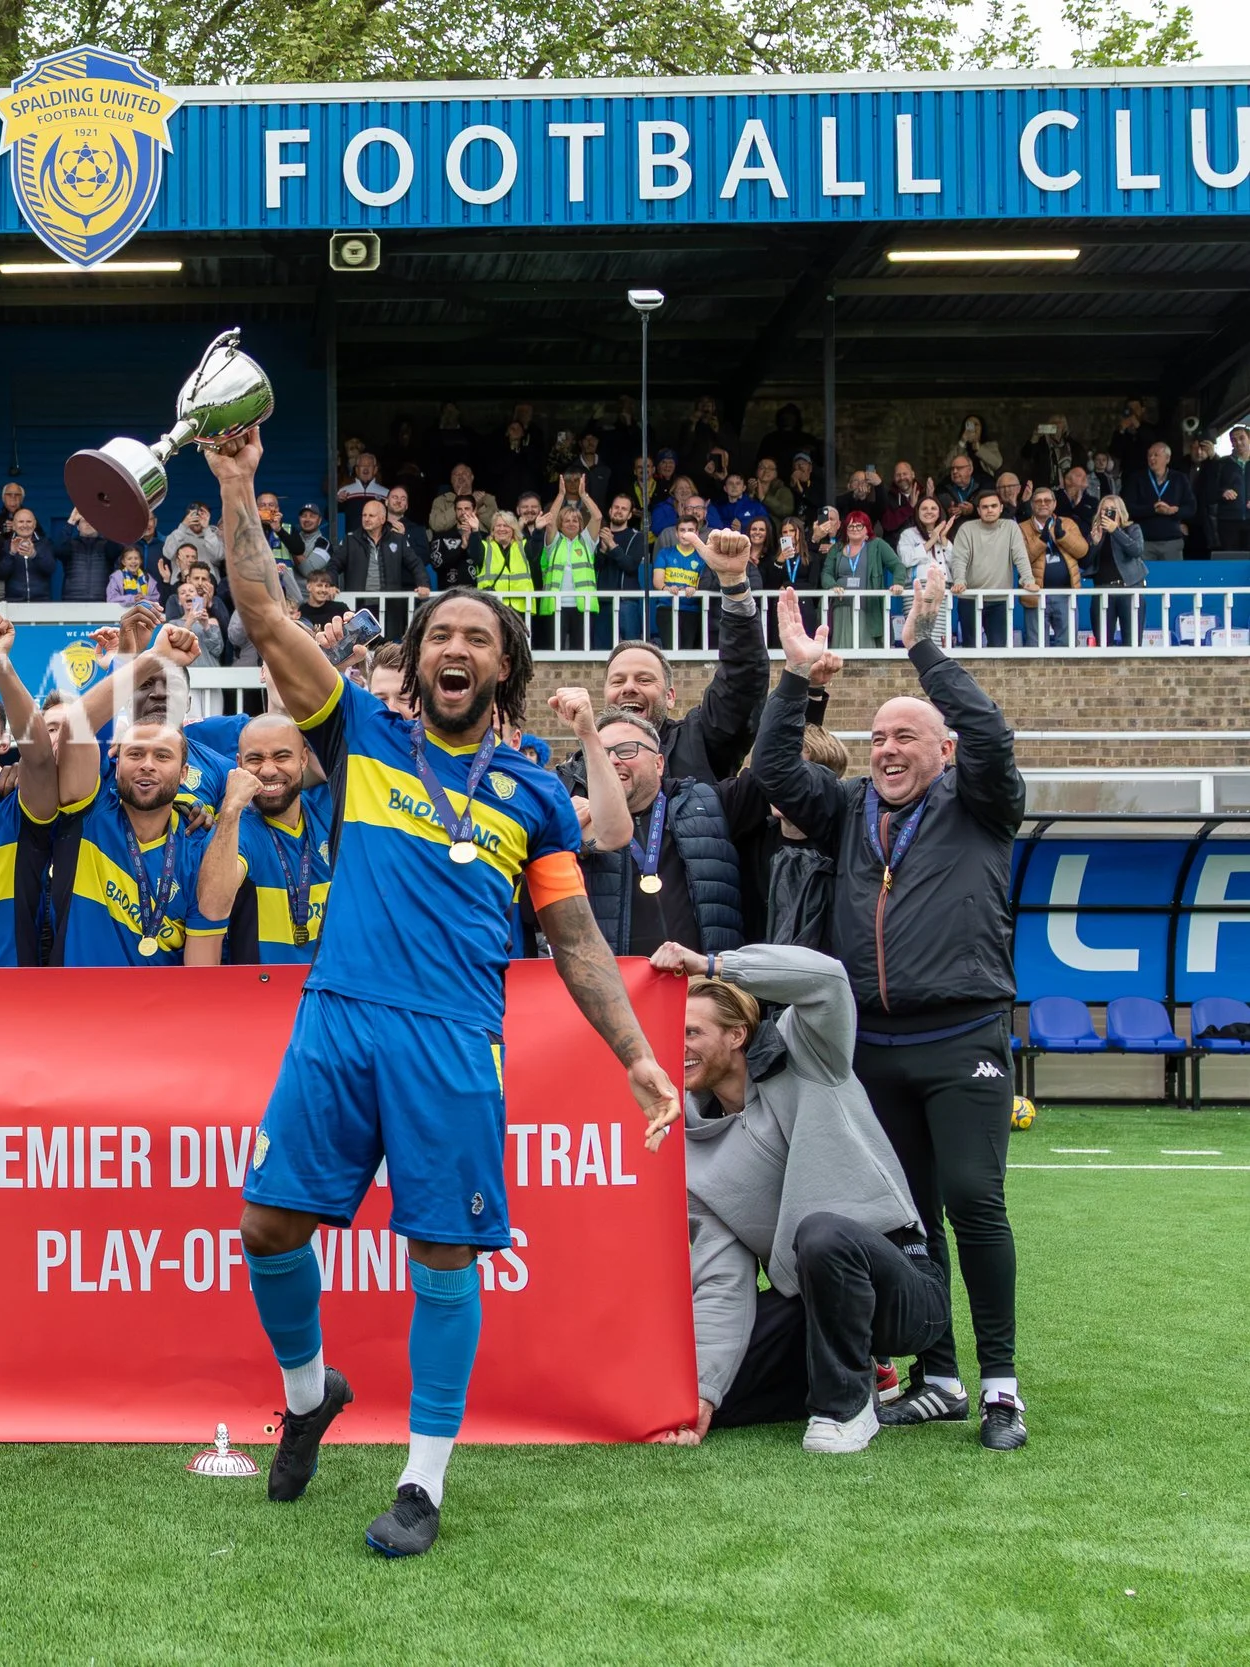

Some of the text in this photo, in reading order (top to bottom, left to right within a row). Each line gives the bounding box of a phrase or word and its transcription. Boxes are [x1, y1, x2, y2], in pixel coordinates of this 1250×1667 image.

[10, 87, 161, 118] SPALDING UNITED
[37, 107, 134, 124] FOOTBALL CLUB
[74, 128, 98, 137] 1921
[264, 113, 941, 209] FOOTBALL
[1019, 107, 1250, 192] CLU
[387, 787, 502, 854] BADNO
[106, 880, 174, 939] BADRO
[507, 1122, 637, 1187] TRAL
[37, 1228, 252, 1292] PLAY-OF
[310, 1227, 529, 1292] WINS
